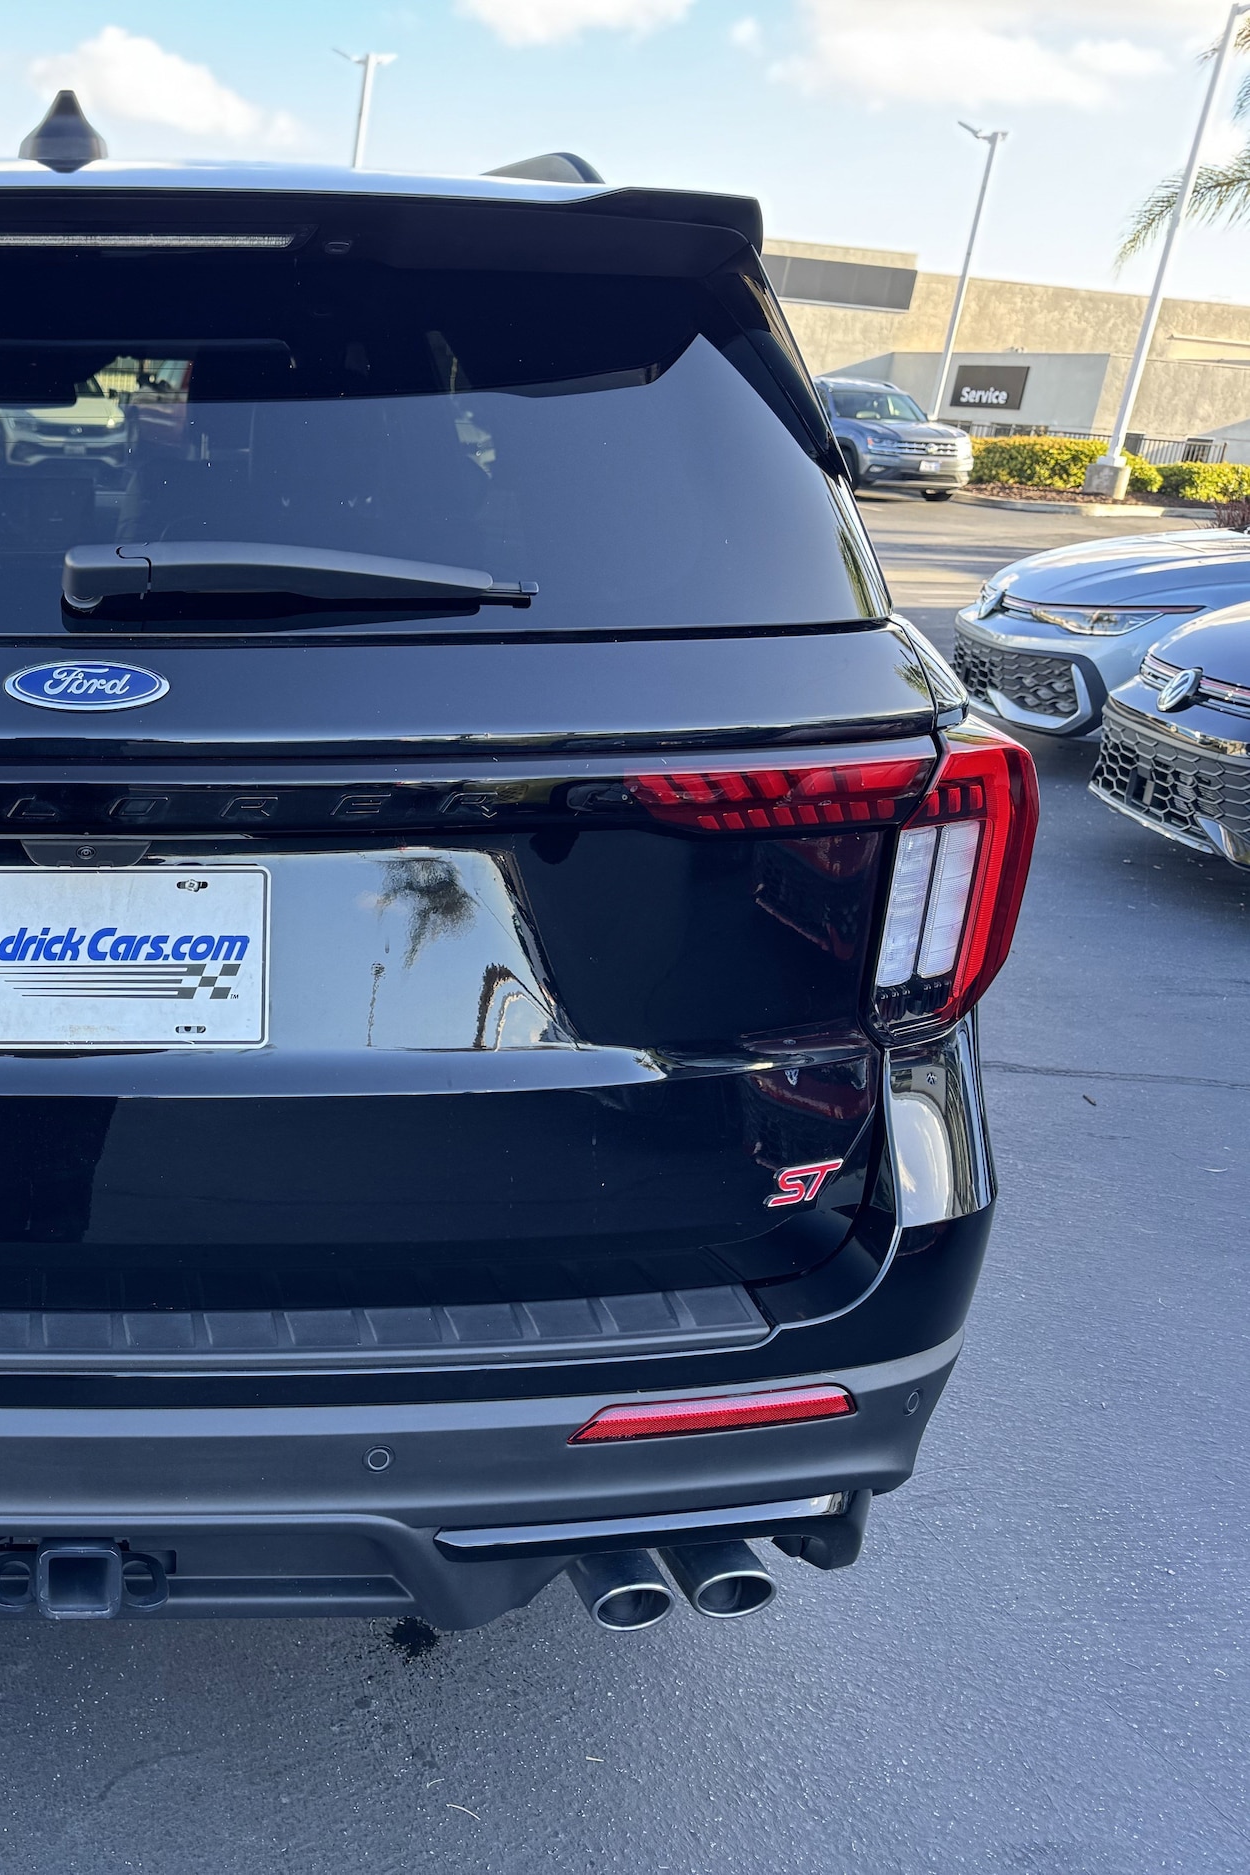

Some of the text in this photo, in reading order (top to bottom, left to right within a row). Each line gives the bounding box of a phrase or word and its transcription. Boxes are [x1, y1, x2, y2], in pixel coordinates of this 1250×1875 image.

[959, 386, 1008, 405] Service
[43, 667, 132, 695] Ford
[765, 1158, 844, 1208] ST
